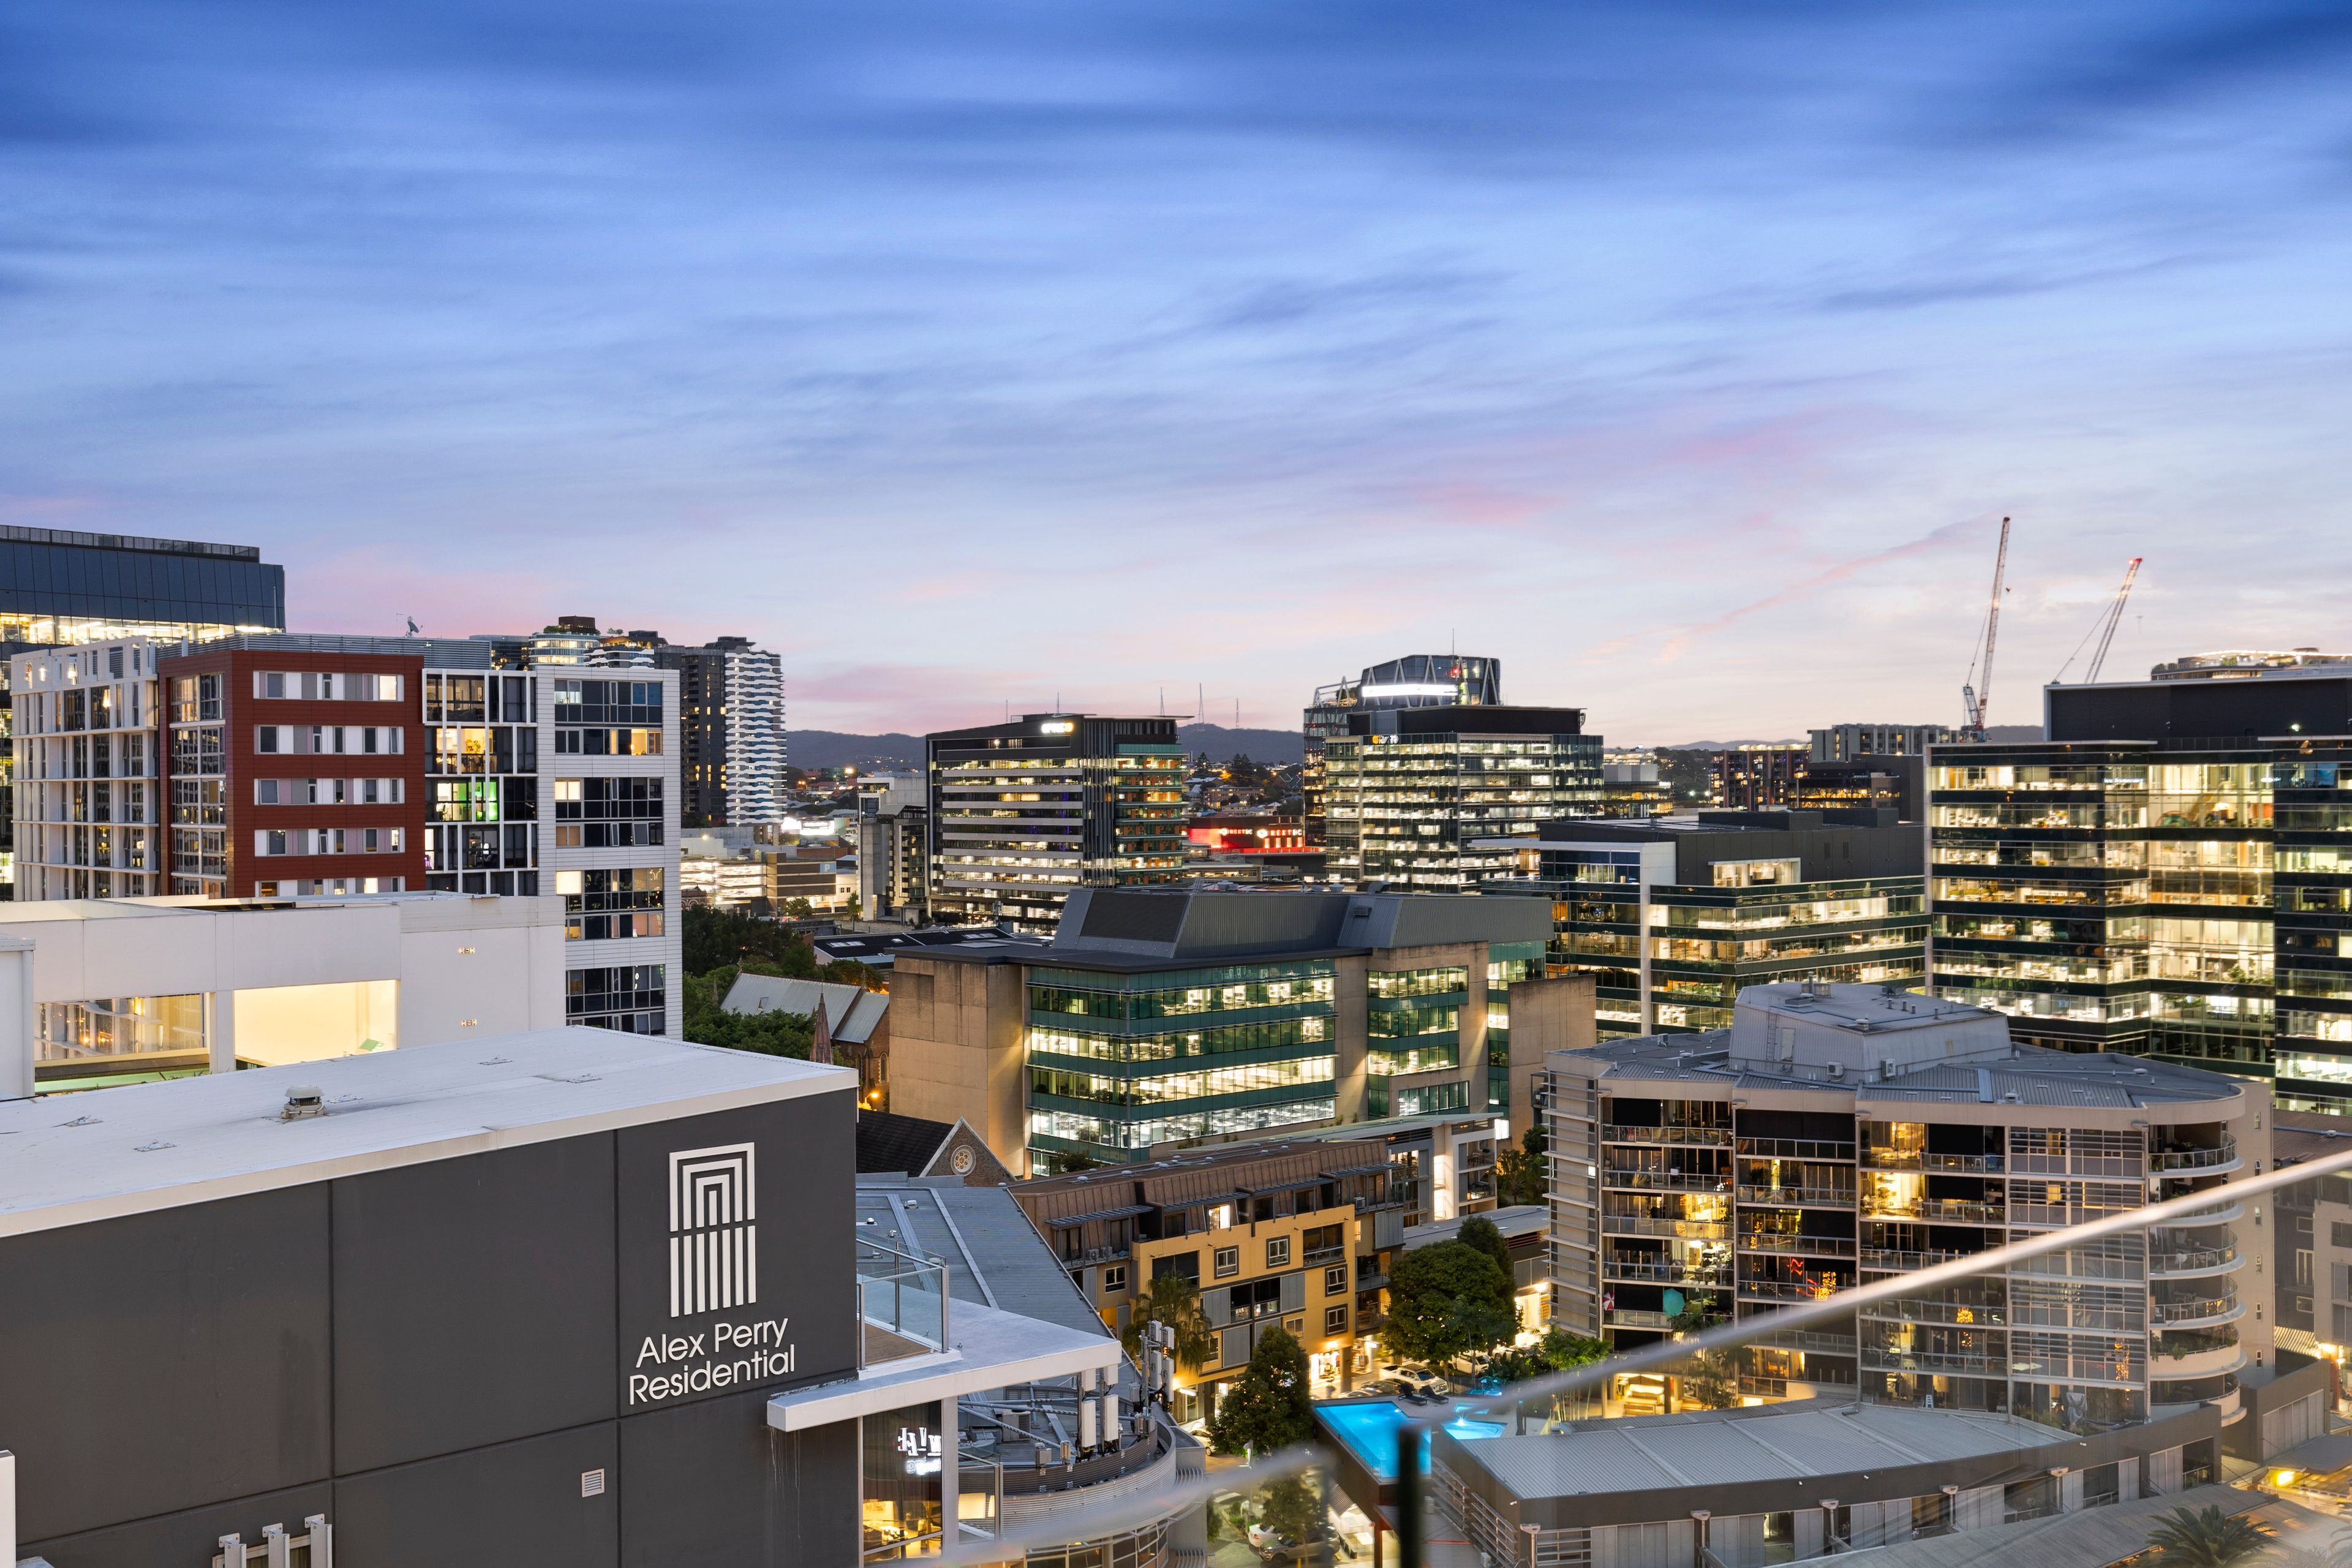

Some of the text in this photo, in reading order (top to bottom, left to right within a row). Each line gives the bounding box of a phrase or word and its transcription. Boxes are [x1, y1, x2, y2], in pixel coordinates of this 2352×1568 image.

[635, 1318, 788, 1368] Alex Perry
[629, 1344, 795, 1405] Residential
